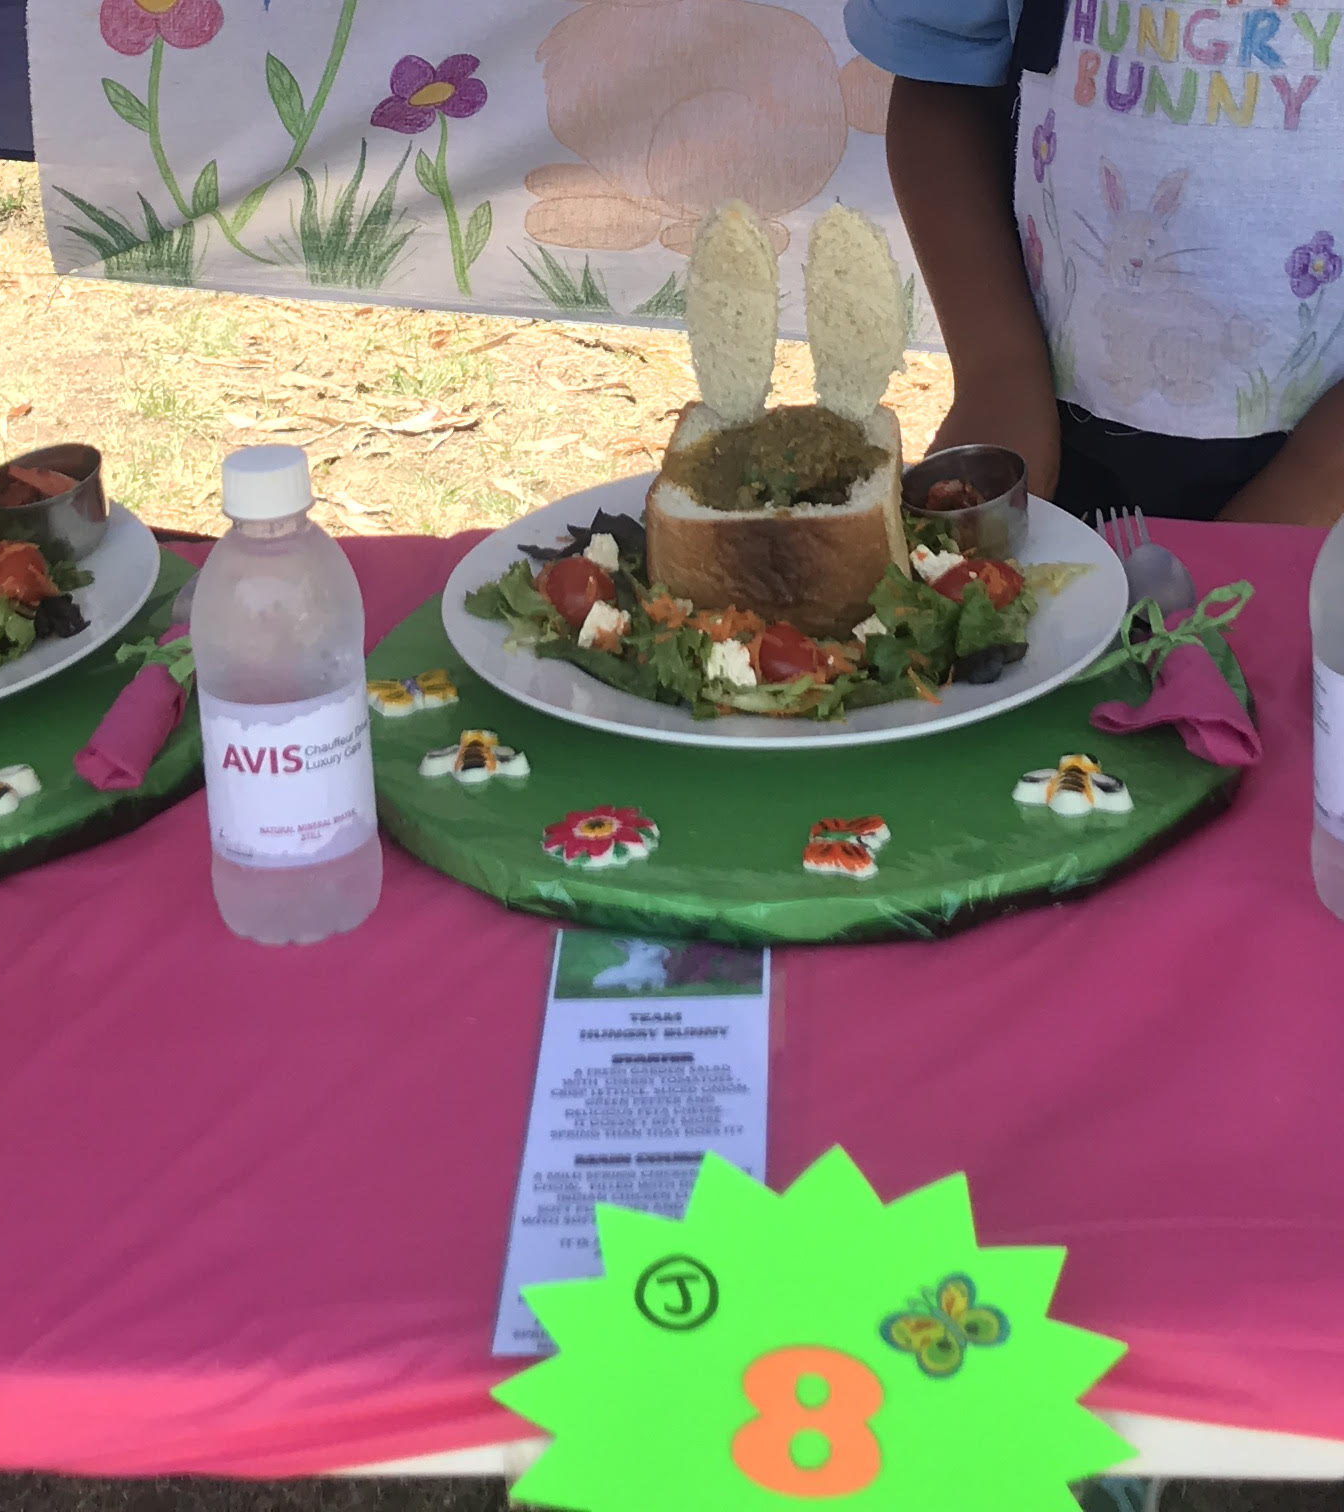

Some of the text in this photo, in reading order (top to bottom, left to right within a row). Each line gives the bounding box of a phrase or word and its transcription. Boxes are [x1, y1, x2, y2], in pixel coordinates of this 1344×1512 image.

[1074, 50, 1322, 130] BUNNY
[222, 744, 304, 775] AVIS
[305, 752, 341, 770] Luxury
[656, 1272, 700, 1316] J
[732, 1344, 884, 1498] 8
